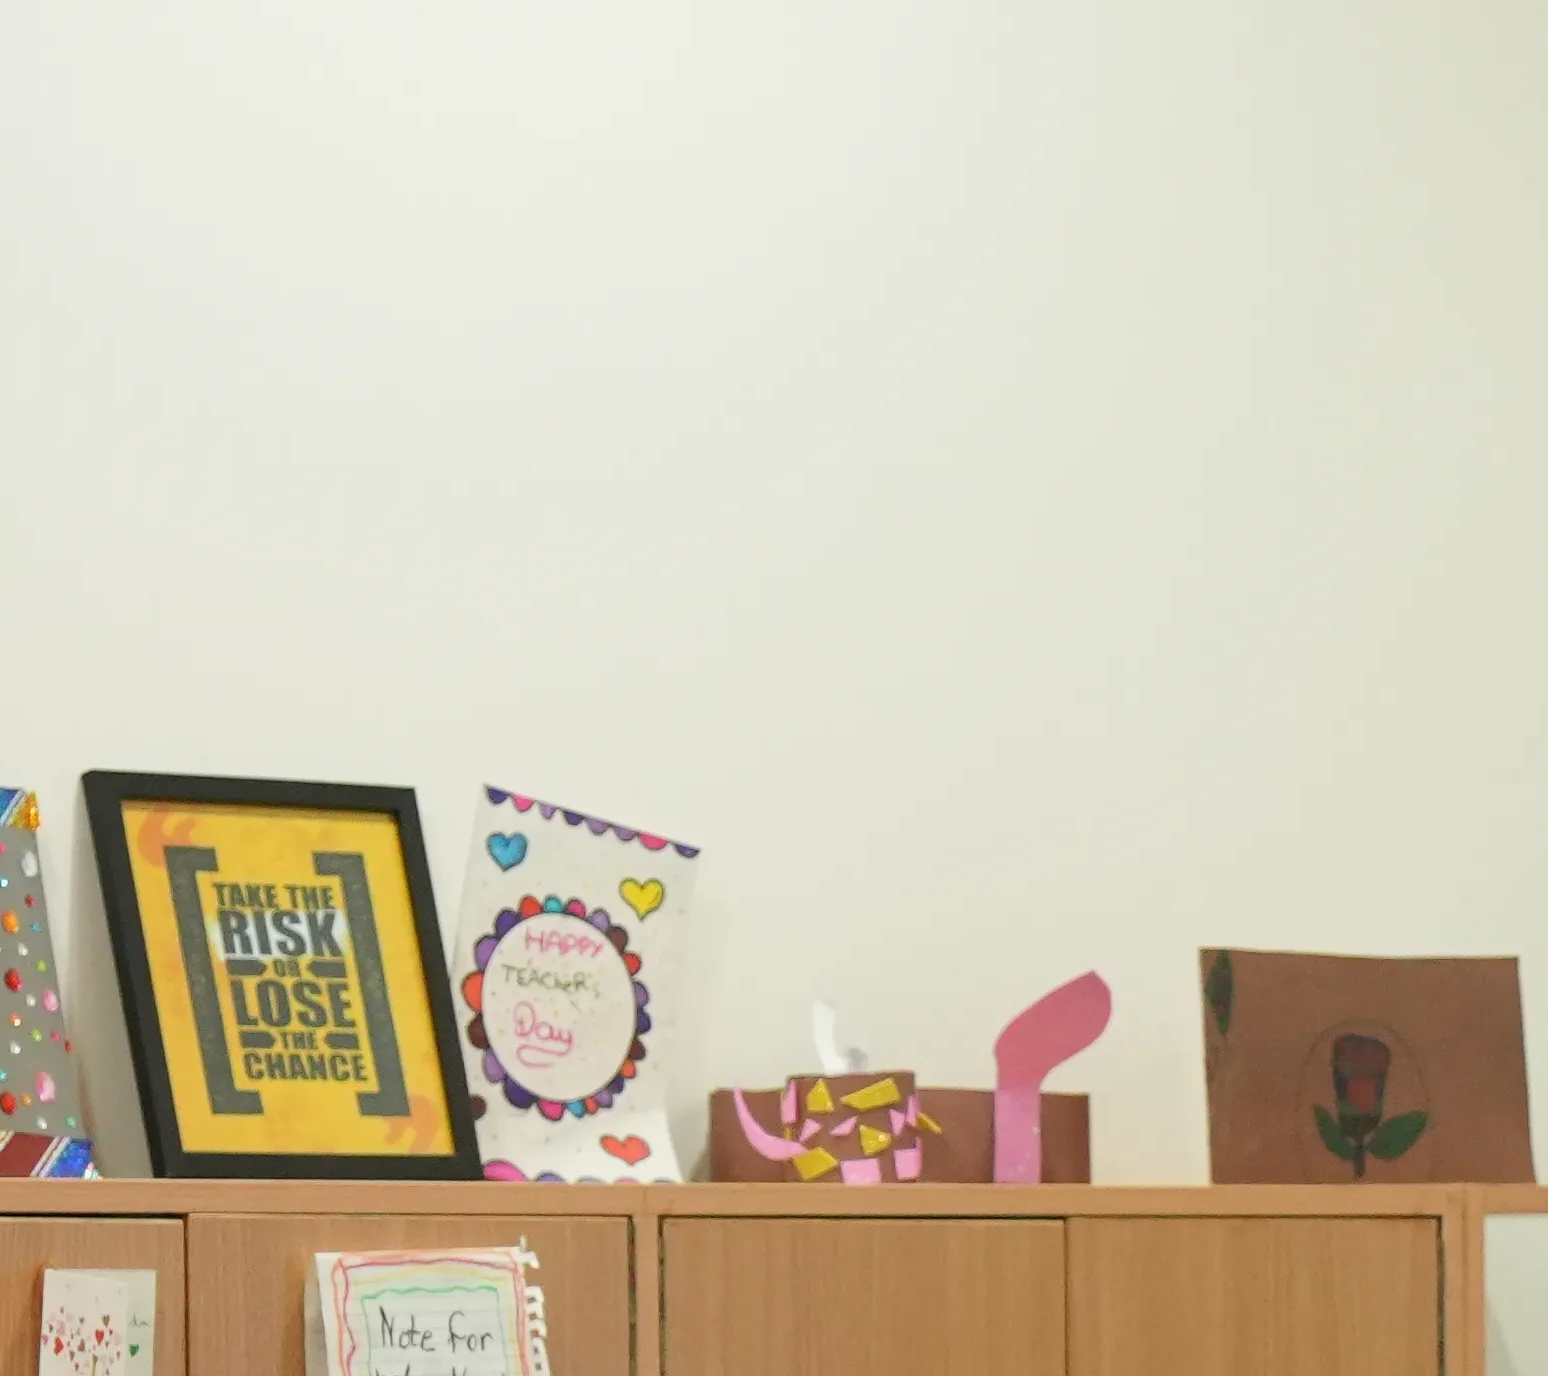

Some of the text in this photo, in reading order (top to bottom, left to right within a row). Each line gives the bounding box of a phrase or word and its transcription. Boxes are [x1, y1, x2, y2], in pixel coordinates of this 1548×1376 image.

[213, 882, 338, 912] TAKE THE
[218, 910, 343, 957] RISK
[272, 958, 302, 978] OR
[231, 978, 357, 1028] LOSE
[279, 1030, 319, 1050] THE
[513, 1001, 575, 1058] Day
[244, 1052, 369, 1081] CHANCE
[379, 1305, 435, 1352] Note
